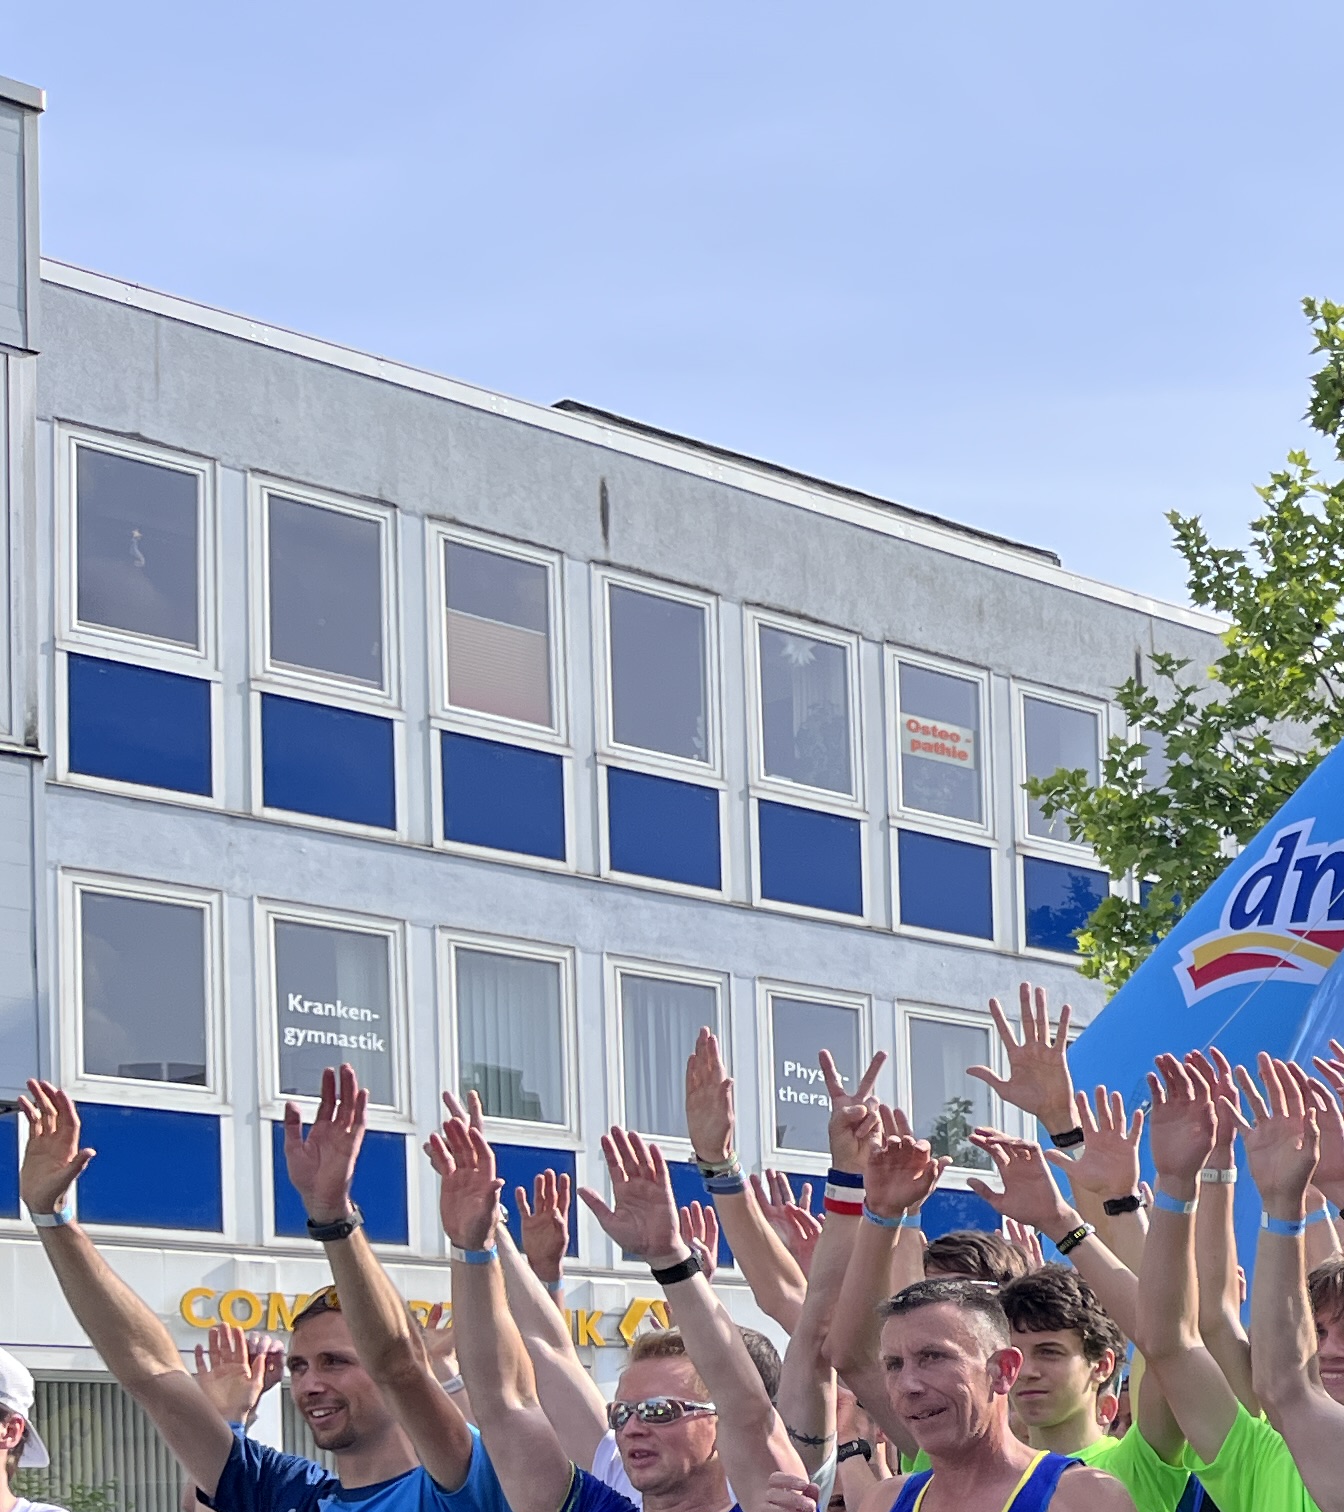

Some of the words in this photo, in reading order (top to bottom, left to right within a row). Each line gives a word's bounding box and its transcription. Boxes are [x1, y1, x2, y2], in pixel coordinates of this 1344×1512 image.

[288, 993, 380, 1022] Kranken-
[284, 1027, 385, 1052] gymnastik
[783, 1060, 849, 1085] Phys-
[779, 1086, 833, 1112] thera
